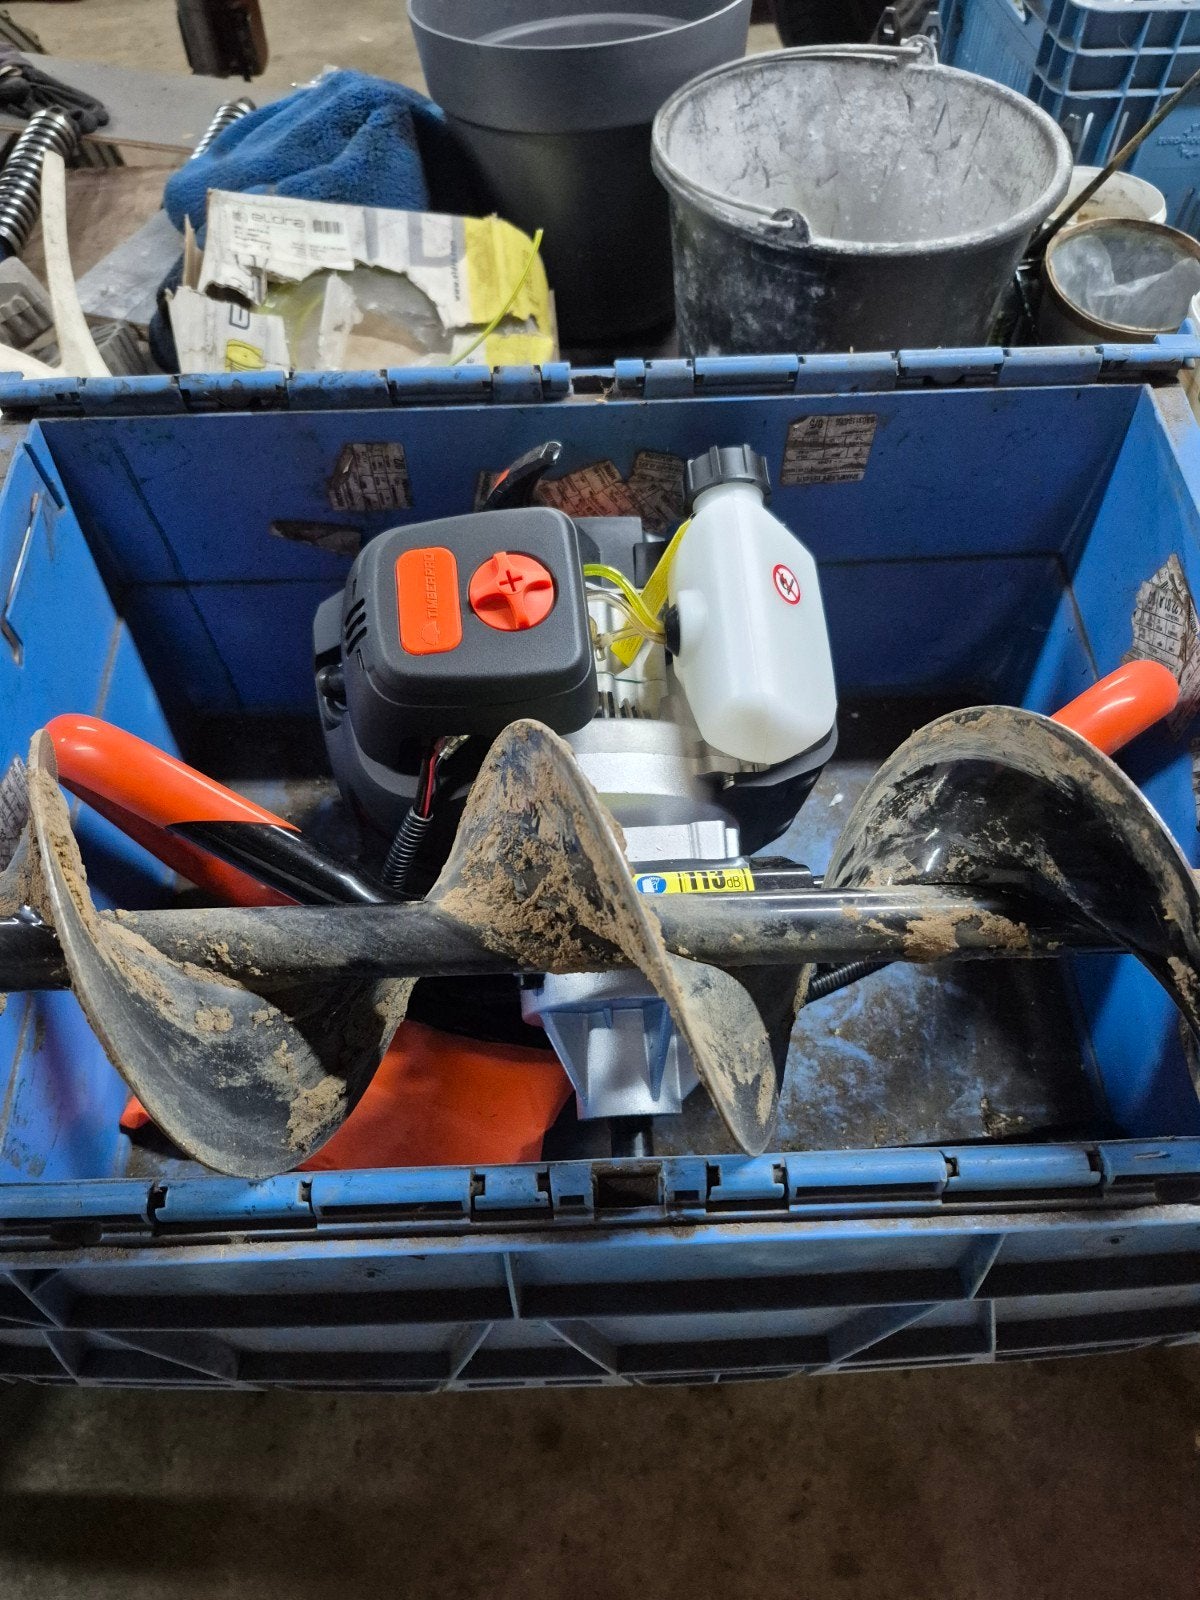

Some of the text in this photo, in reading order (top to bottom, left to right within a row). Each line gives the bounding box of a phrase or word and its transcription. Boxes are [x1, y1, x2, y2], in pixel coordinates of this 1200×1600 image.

[423, 553, 438, 619] TIMBERPRO
[685, 871, 742, 890] 113 dB
